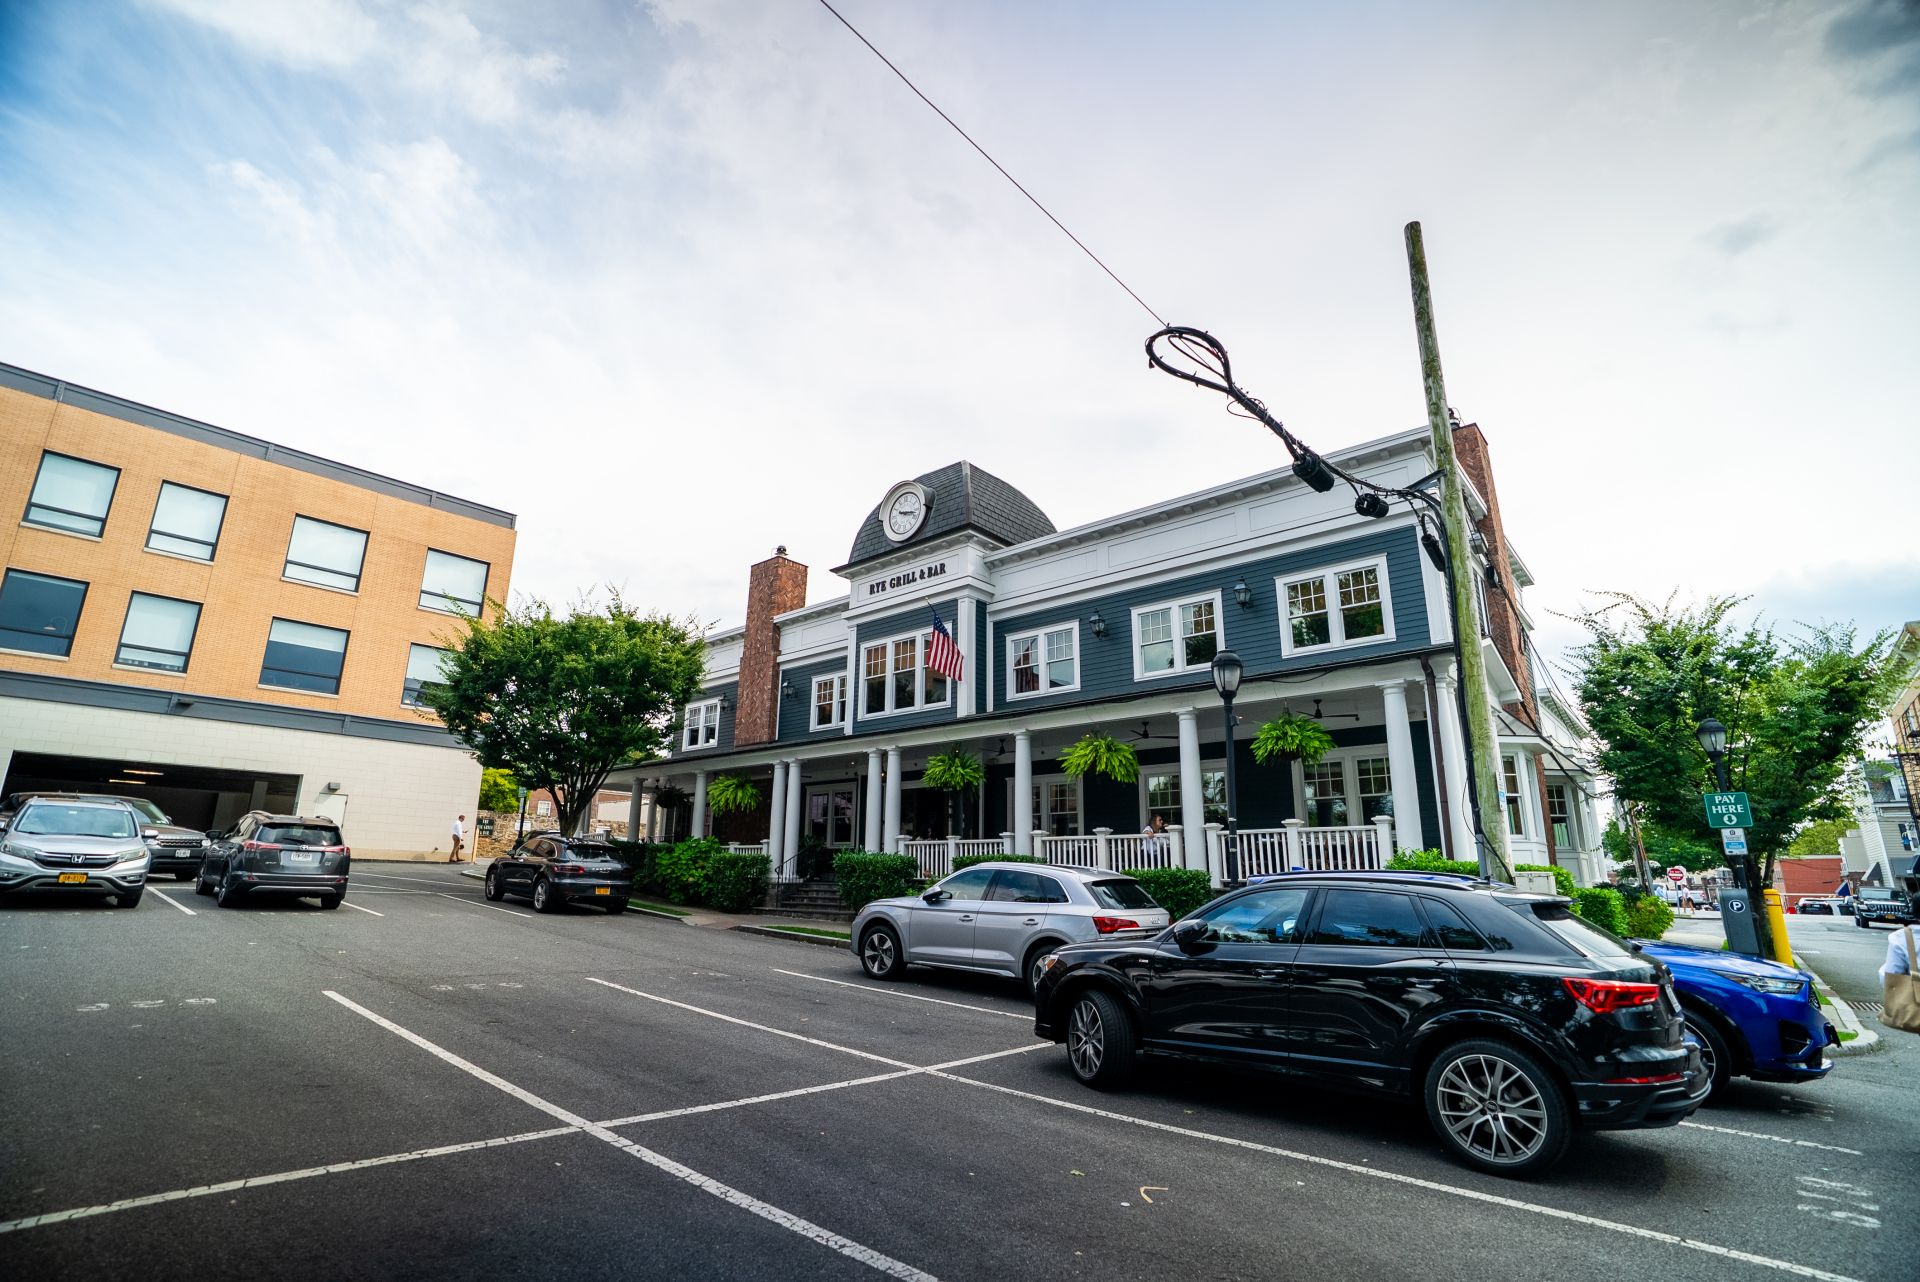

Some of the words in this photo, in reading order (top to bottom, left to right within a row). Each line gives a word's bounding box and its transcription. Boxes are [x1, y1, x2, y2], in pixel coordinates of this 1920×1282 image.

[869, 580, 886, 595] RYE
[889, 571, 917, 588] GRILL
[919, 569, 926, 580] &
[927, 563, 946, 577] BAR
[1714, 794, 1736, 804] PAY
[1712, 804, 1744, 814] HERE
